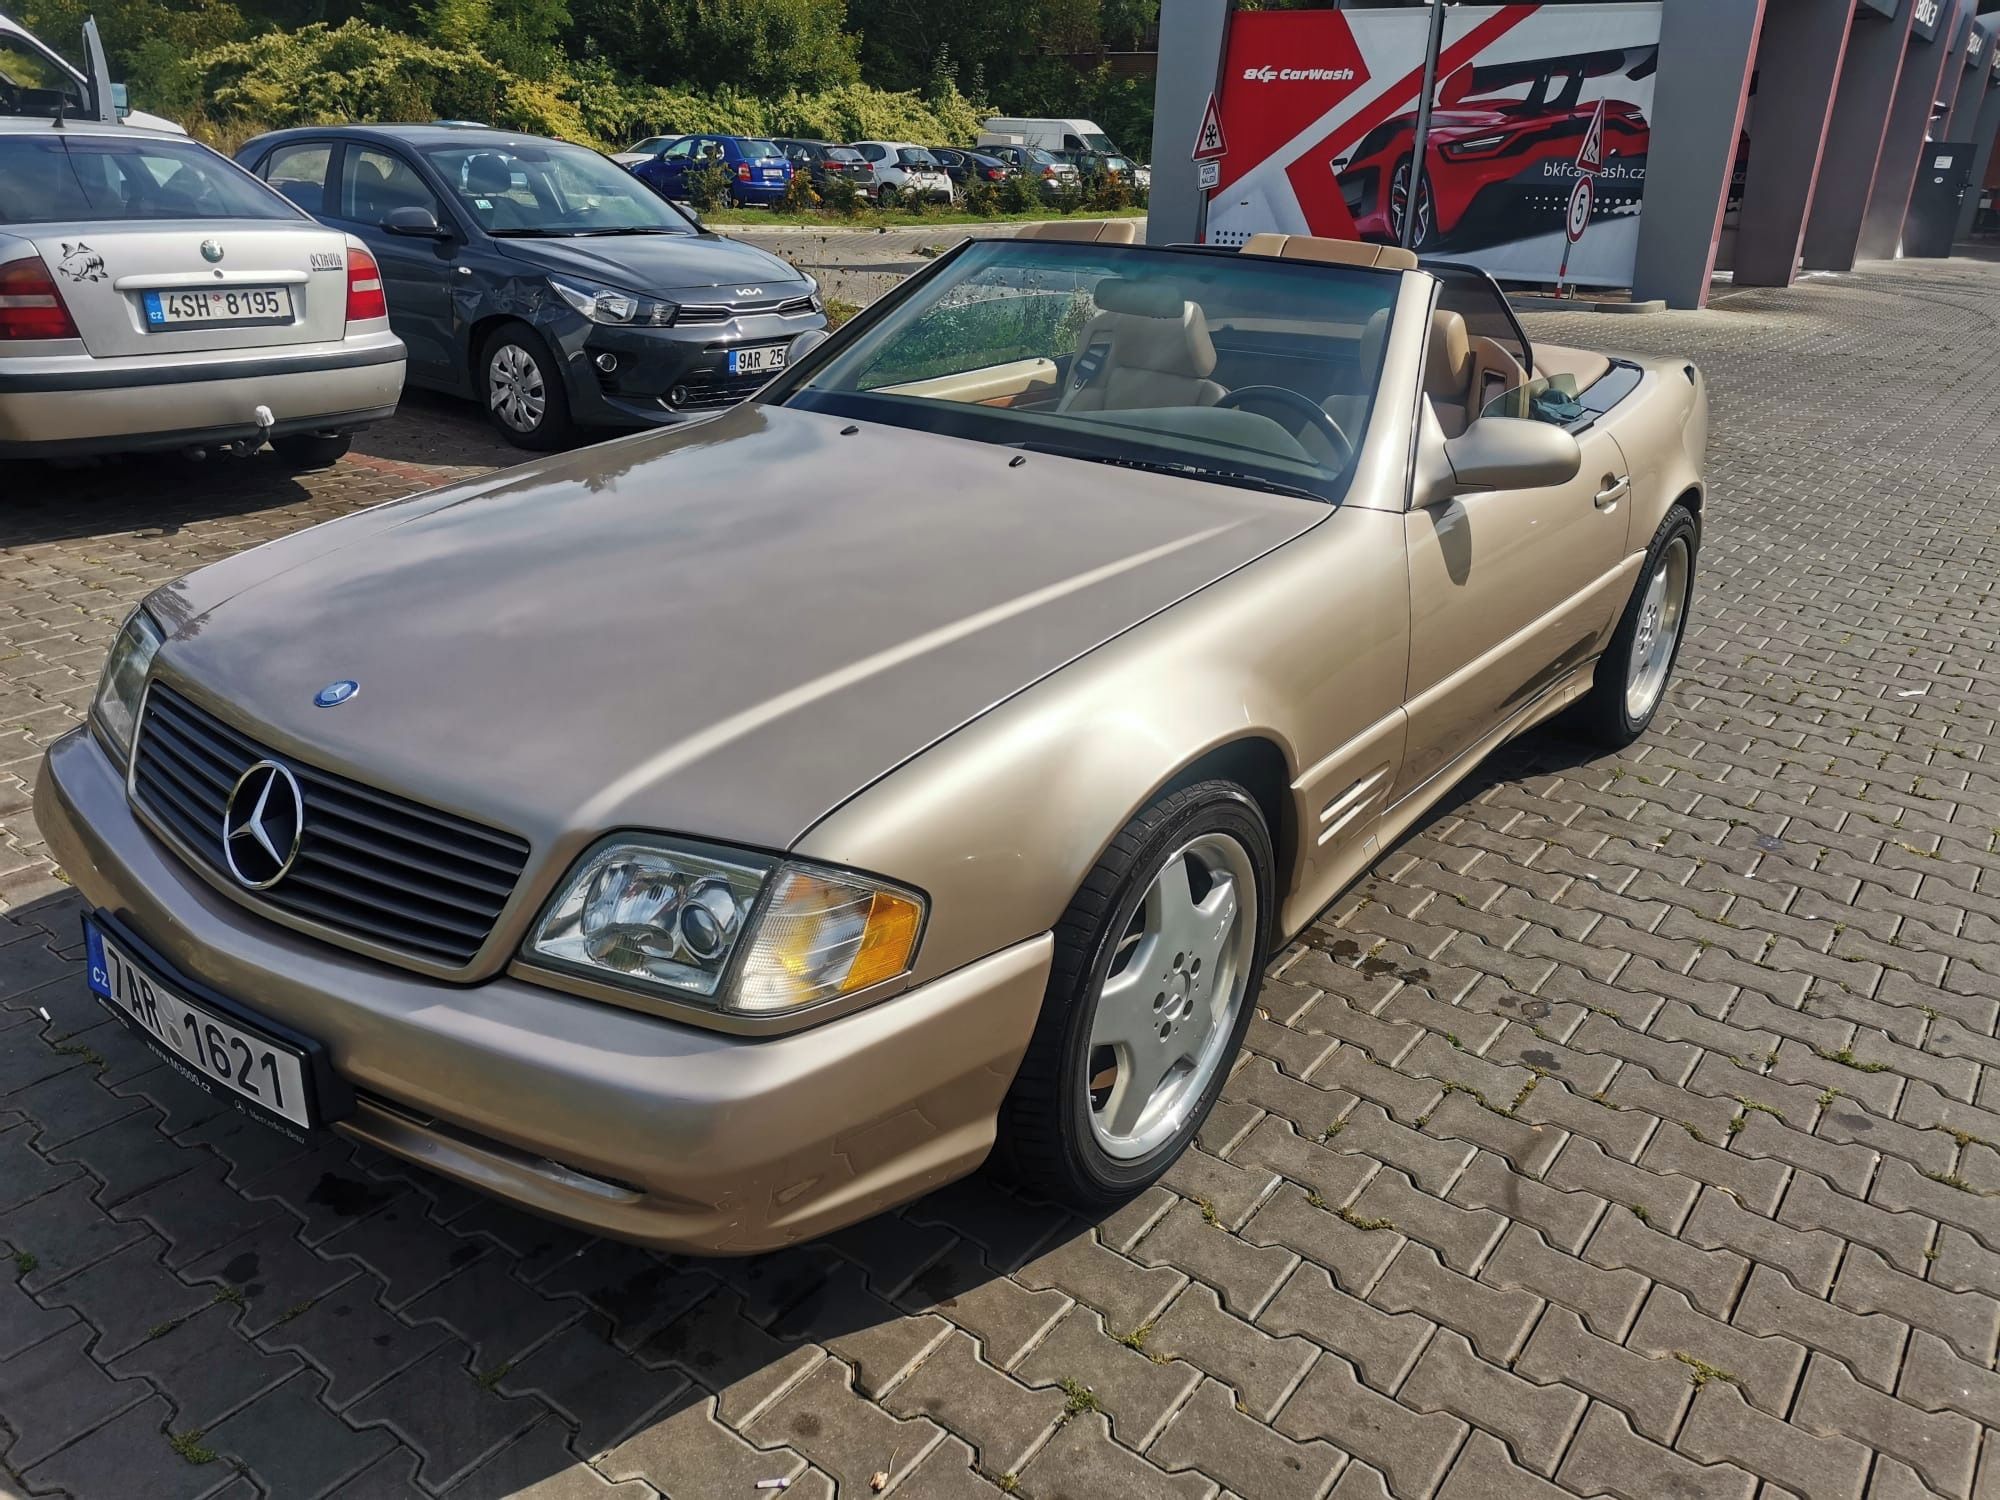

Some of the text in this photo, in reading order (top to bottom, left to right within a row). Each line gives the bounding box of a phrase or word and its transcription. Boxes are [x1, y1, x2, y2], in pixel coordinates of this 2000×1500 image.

[1280, 68, 1354, 80] CarWash
[1543, 161, 1646, 179] bkfcaash.cz
[1576, 194, 1586, 225] 5
[310, 253, 343, 267] OCTAVIA
[151, 291, 280, 320] CZ 4SH 8195
[739, 352, 760, 369] 9AR
[92, 946, 284, 1109] CZ 7AR 1621
